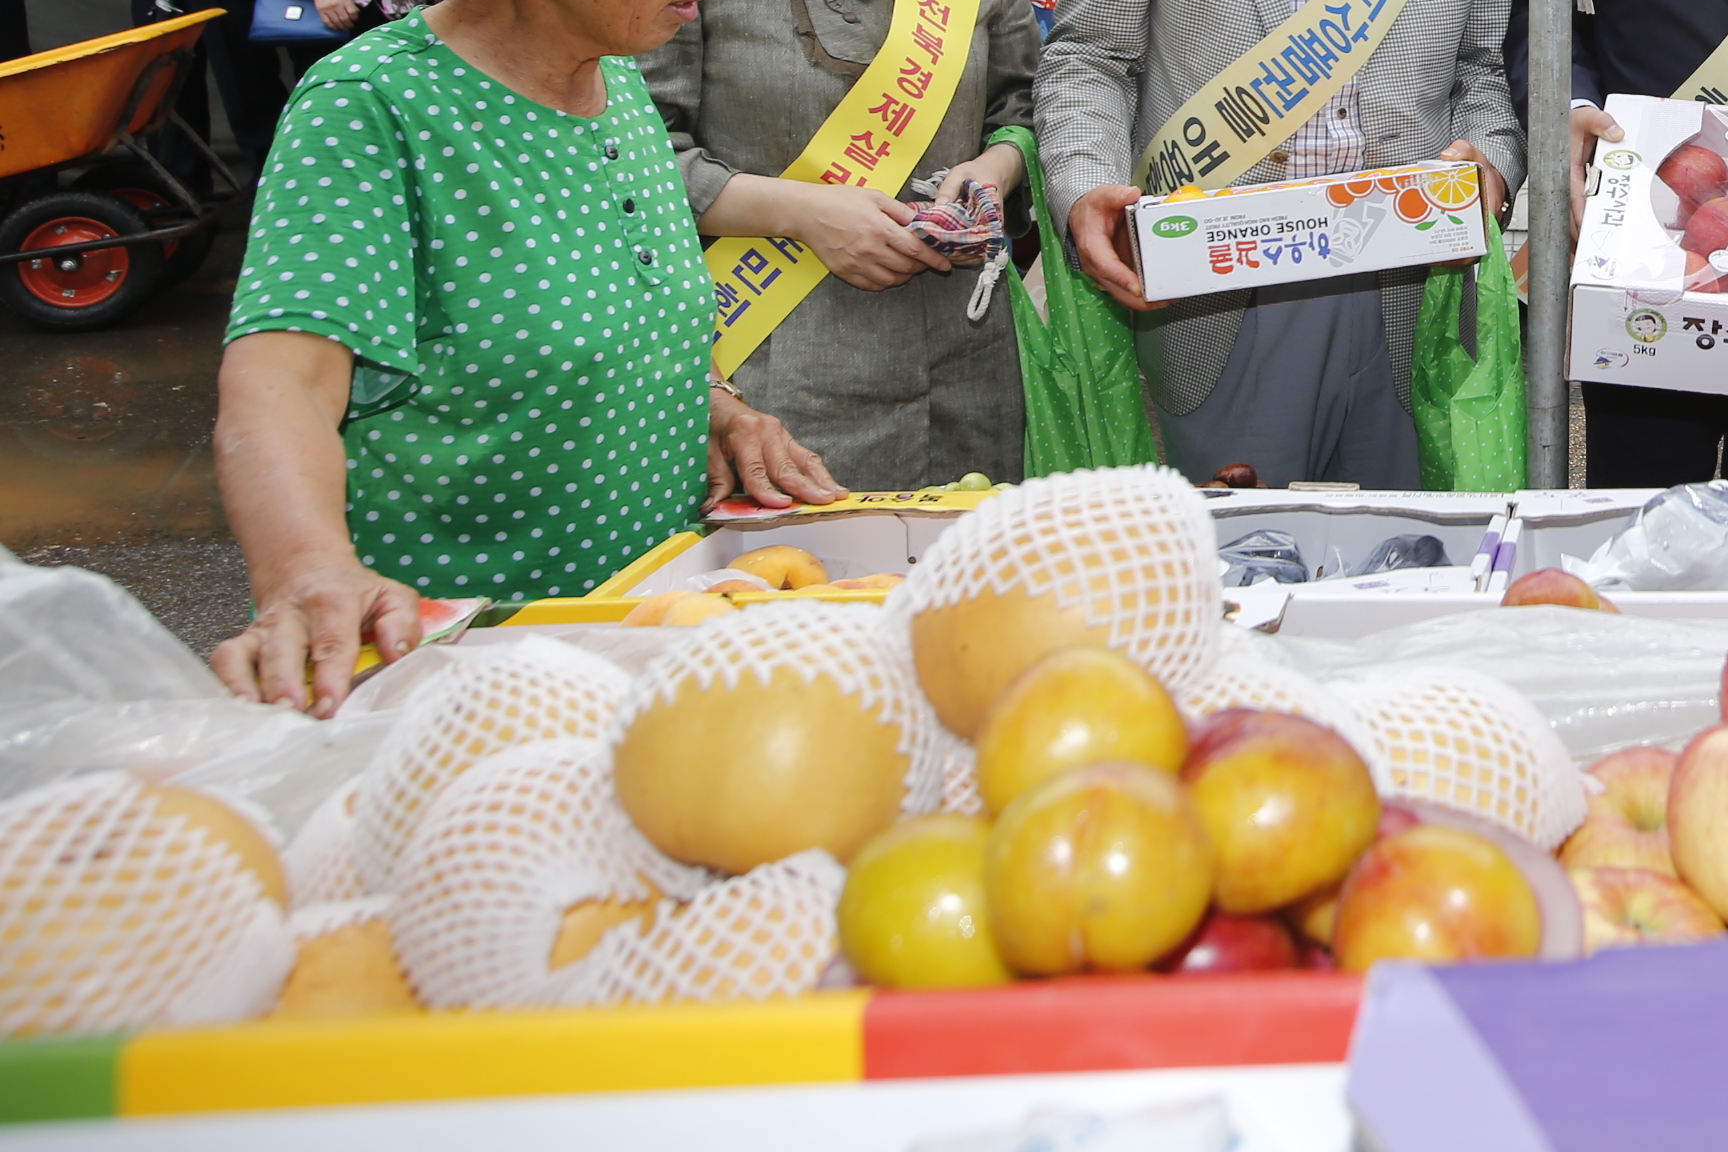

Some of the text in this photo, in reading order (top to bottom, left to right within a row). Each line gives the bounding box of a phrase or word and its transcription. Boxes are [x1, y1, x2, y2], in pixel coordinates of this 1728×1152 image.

[1601, 173, 1631, 228] 장수사과
[1160, 220, 1191, 232] 3kg
[1206, 216, 1329, 242] HOUSE ORANGE
[1633, 344, 1656, 356] 5kg
